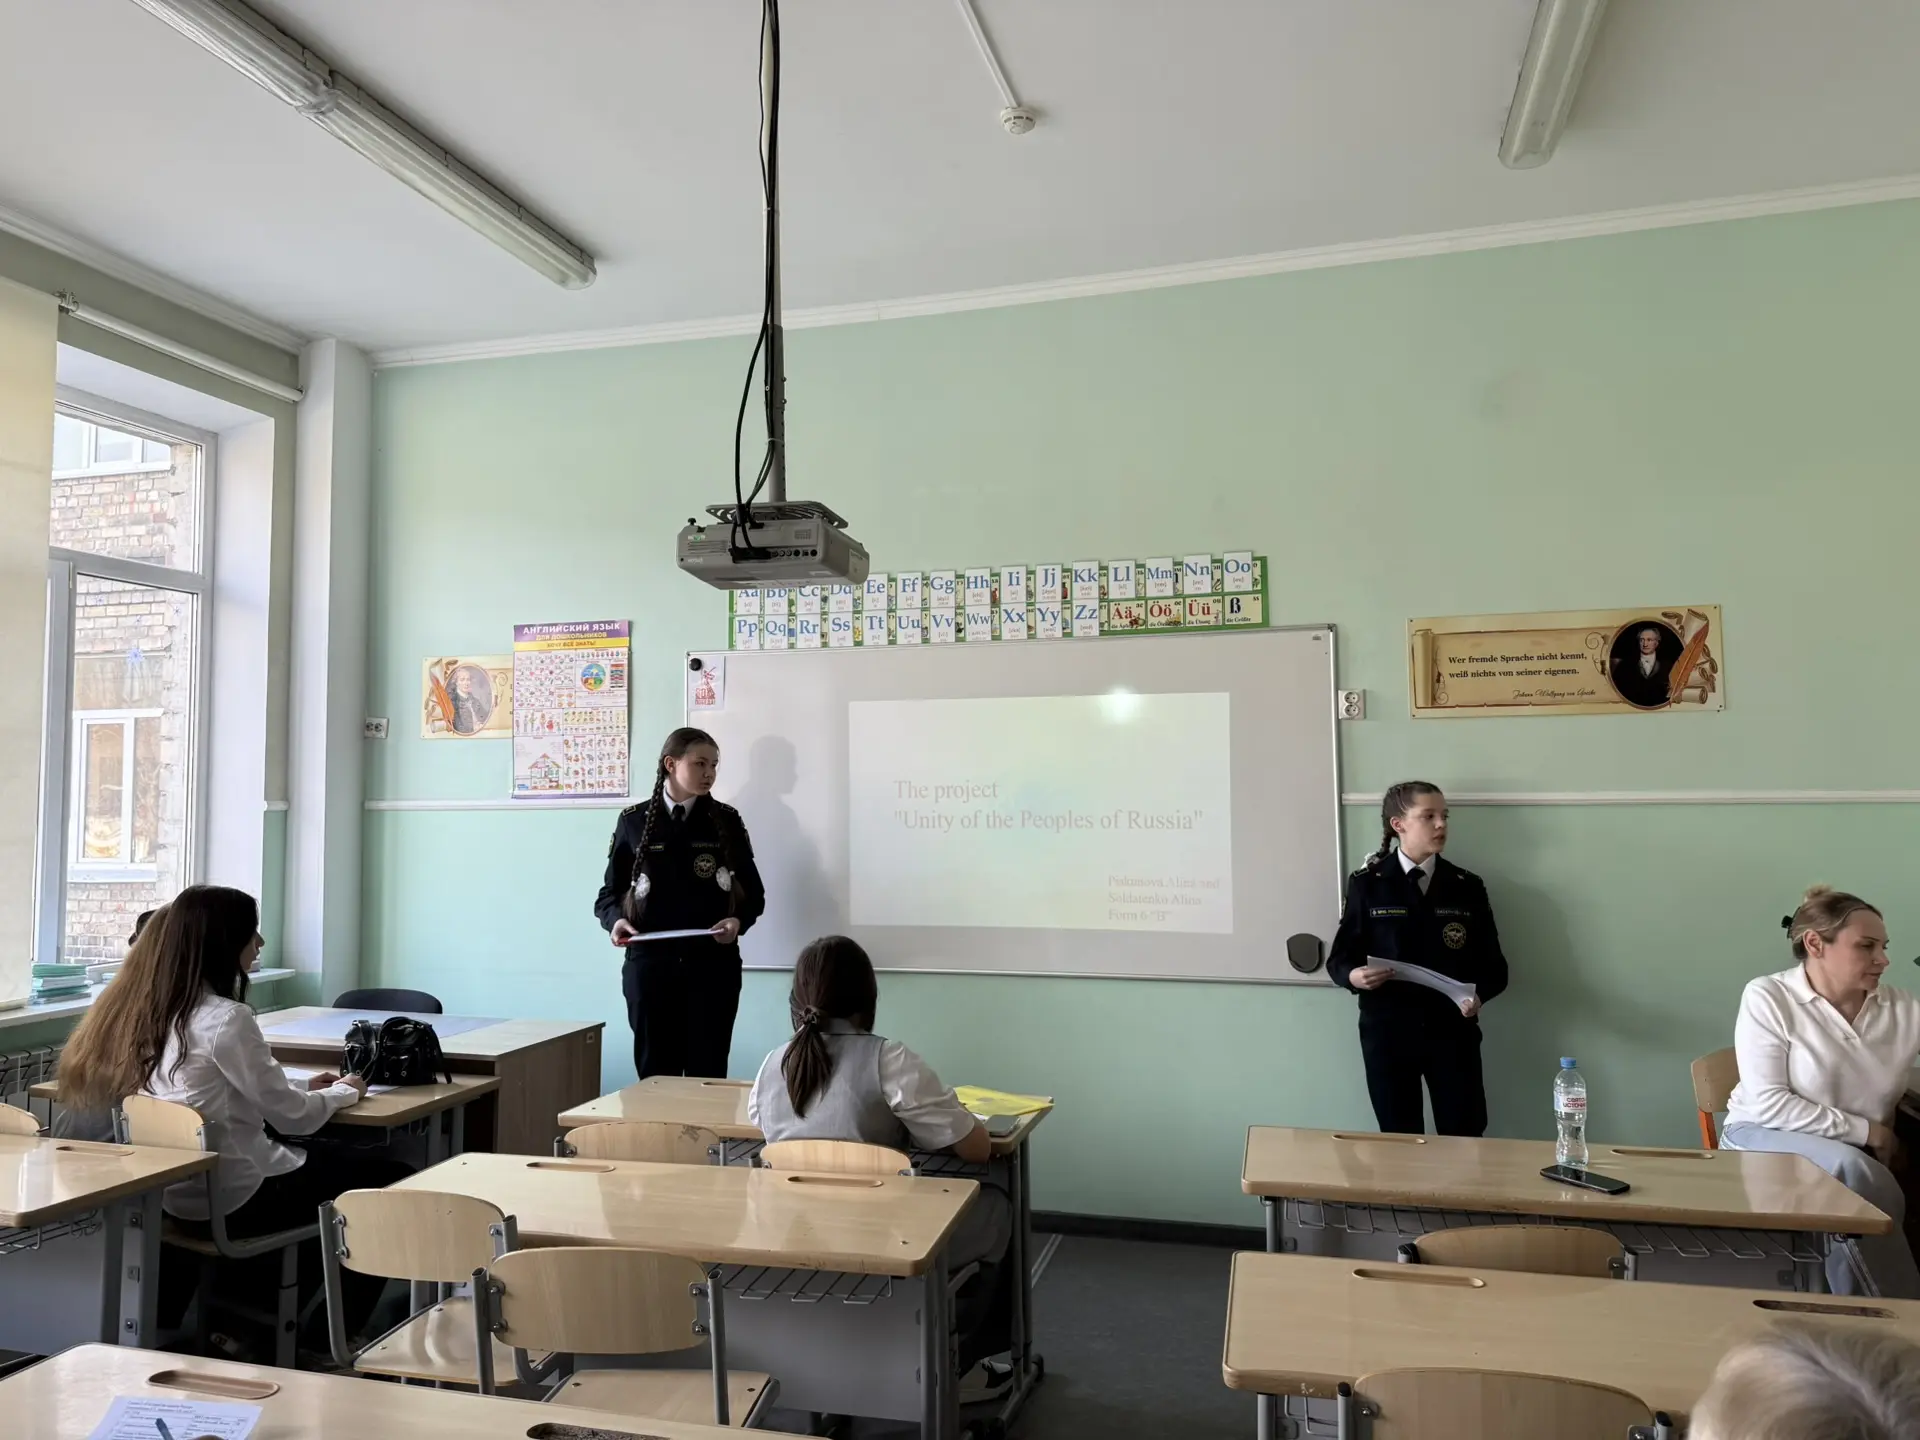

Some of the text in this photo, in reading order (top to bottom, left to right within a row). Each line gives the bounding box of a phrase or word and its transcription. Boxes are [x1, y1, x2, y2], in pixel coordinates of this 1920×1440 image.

[866, 580, 885, 594] Ee
[901, 577, 919, 592] Ff
[930, 576, 955, 594] Gg
[966, 575, 990, 590] Hh
[1008, 572, 1020, 586] Ii
[1042, 568, 1056, 588] Jj
[1074, 568, 1098, 583] Kk
[1112, 566, 1132, 582] Ll
[1147, 567, 1172, 580] Mm
[1184, 562, 1212, 577] Nn
[1224, 559, 1251, 574] Oo
[1112, 602, 1132, 620] Ää
[1150, 600, 1172, 618] Öö
[1188, 599, 1210, 616] Üü
[523, 623, 620, 634] АНГЛИЙСКИЙ ЯЗЫК
[738, 604, 1098, 637] Pp Qq Rr Ss Tt Uu Vv Ww Xx Yy Zz
[1448, 656, 1466, 664] Wer
[1468, 655, 1498, 663] fremde
[1500, 654, 1534, 664] Sprache
[1560, 652, 1587, 660] kennt,
[1449, 670, 1468, 678] weiß
[1471, 670, 1496, 678] nichts
[1516, 668, 1541, 676] seiner
[1544, 668, 1580, 676] eigenen.
[1535, 688, 1565, 698] Wolfgang
[893, 779, 999, 804] The project
[894, 809, 1203, 834] "Unity of the Peoples of Russia"
